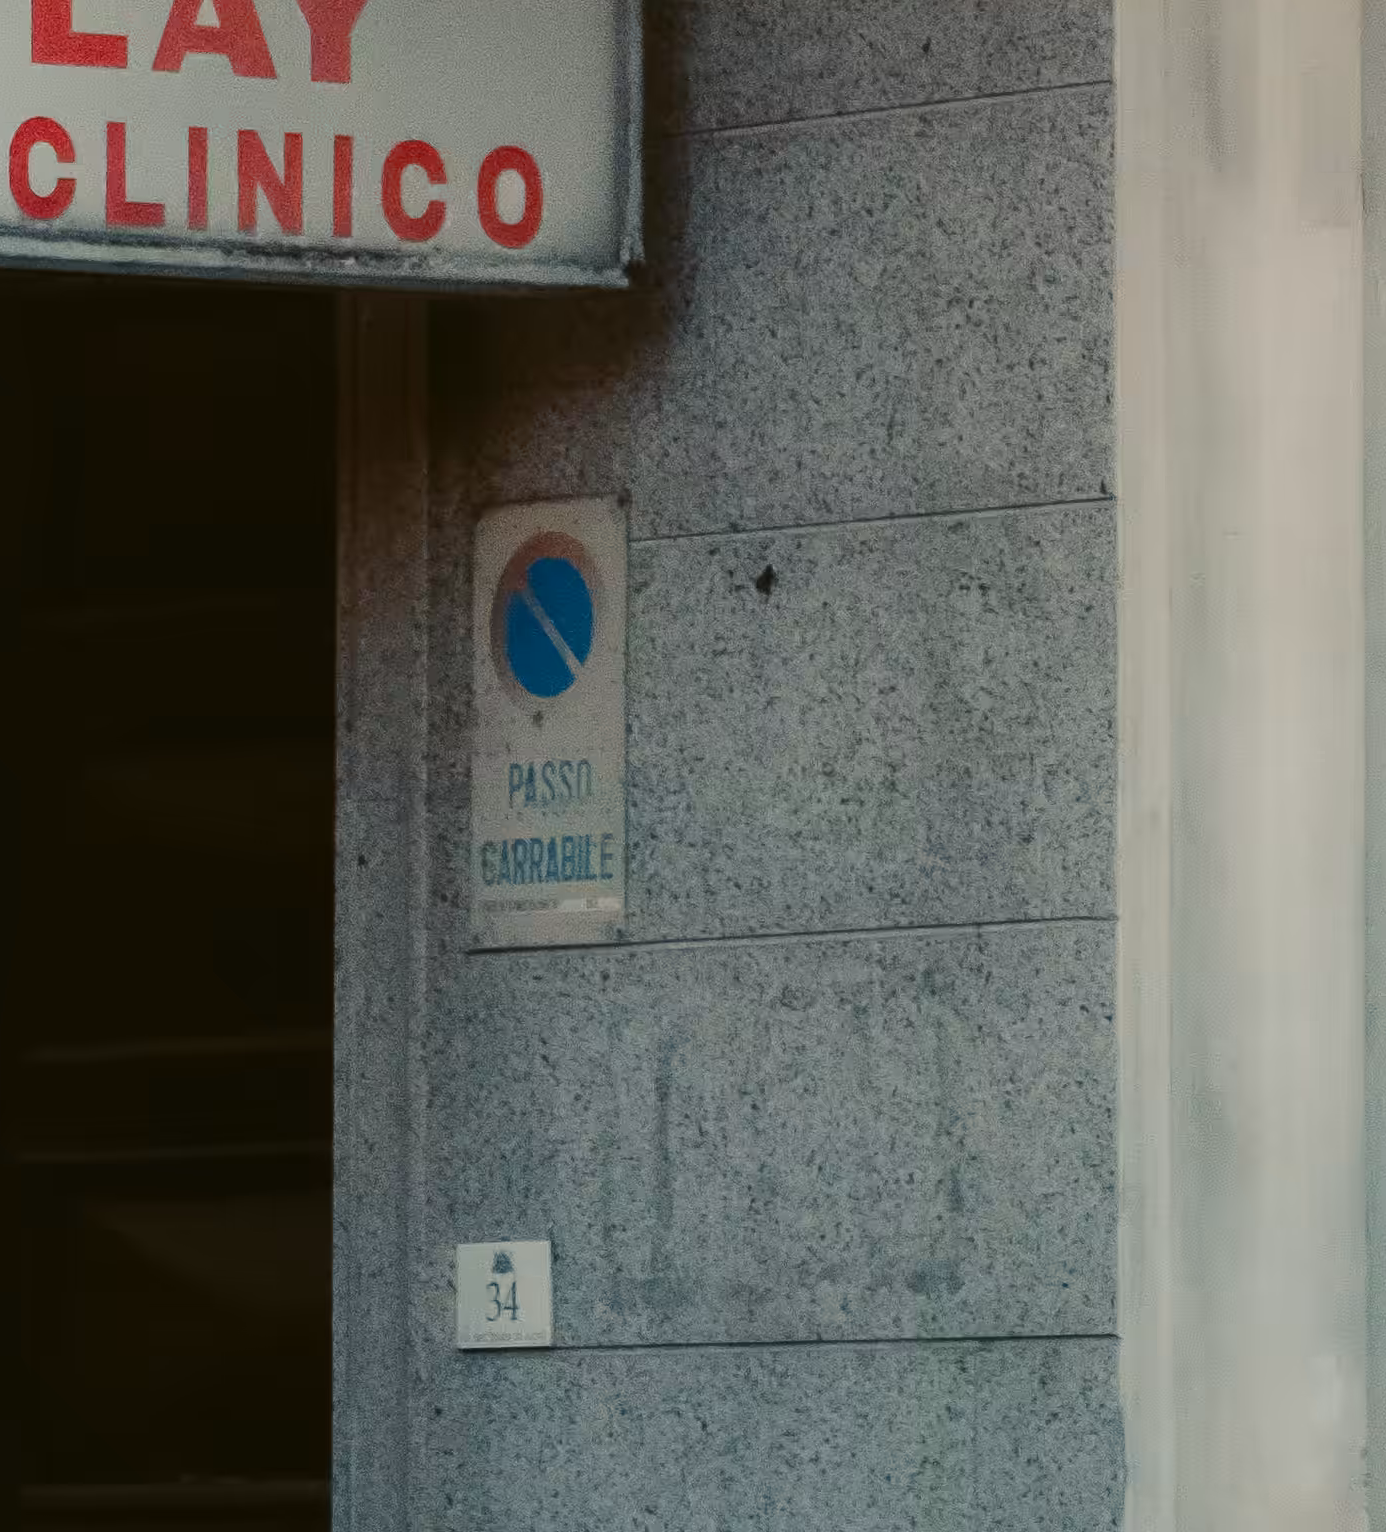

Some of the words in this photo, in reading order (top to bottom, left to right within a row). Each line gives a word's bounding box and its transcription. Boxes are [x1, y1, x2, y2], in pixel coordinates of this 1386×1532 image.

[508, 759, 593, 804] PASSO
[481, 833, 614, 887] CARRABILE
[486, 1280, 519, 1322] 34
